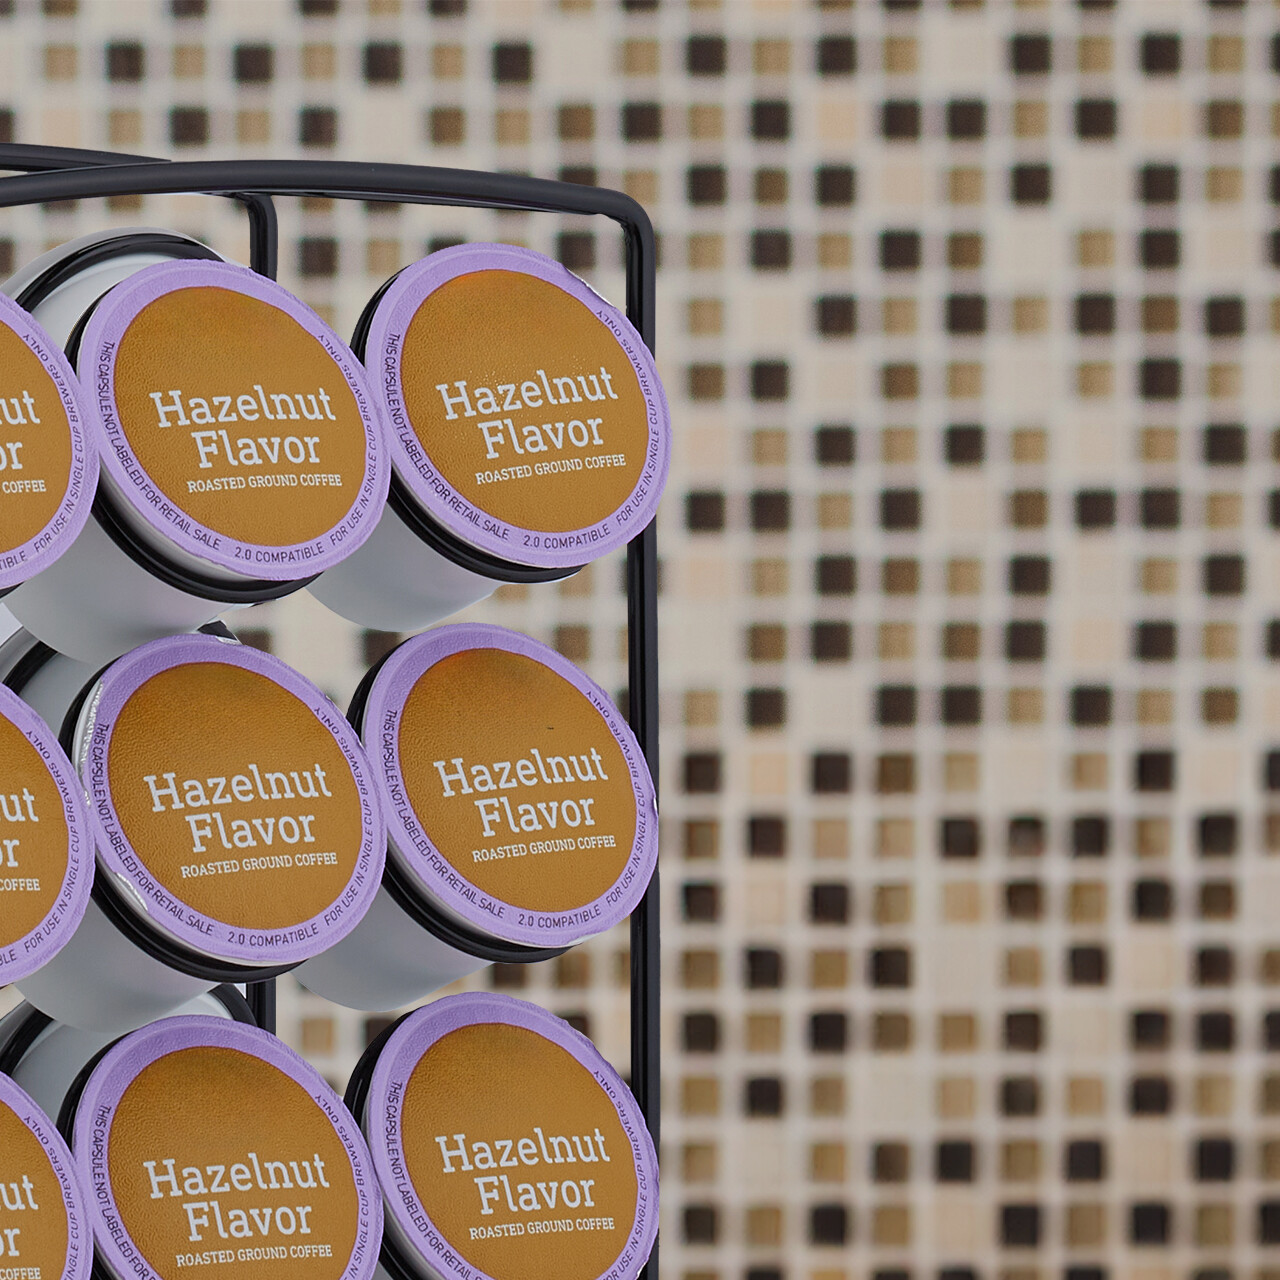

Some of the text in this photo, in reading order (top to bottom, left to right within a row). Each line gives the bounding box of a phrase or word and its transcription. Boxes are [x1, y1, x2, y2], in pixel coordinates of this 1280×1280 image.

[150, 385, 336, 427] Hazelnut
[435, 367, 619, 420] Hazelnut
[22, 332, 84, 553] FOR USE IN SINGLE CUP BREWERS ONLY
[191, 430, 320, 469] Flavor
[477, 417, 603, 459] Flavor
[2, 480, 47, 494] COFFEE
[186, 473, 342, 493] ROASTED GROUND COFFEE
[474, 454, 626, 485] ROASTED GROUND COFFEE
[235, 540, 325, 563] 2.0 COMPATIBLE
[524, 523, 611, 549] 2.0 COMPATIBLE
[143, 763, 332, 812] Hazelnut
[433, 748, 610, 797] Hazelnut
[92, 723, 215, 936] THIS CAPSULE NOT LABELED FOR RETAIL SALE
[185, 812, 315, 853] Flavor
[314, 706, 374, 925] FOR USE IN SINGLE CUP BREWERS ONLY
[473, 796, 595, 837] Flavor
[180, 852, 338, 879] ROASTED GROUND COFFEE
[471, 835, 617, 862] ROASTED GROUND COFFEE
[228, 922, 320, 947] 2.0 COMPATIBLE
[518, 903, 603, 928] 2.0 COMPATIBLE
[435, 1127, 612, 1173] Hazelnut
[143, 1151, 330, 1198] Hazelnut
[473, 1174, 595, 1215] Flavor
[182, 1200, 312, 1241] Flavor
[468, 1218, 616, 1240] ROASTED GROUND COFFEE
[175, 1245, 332, 1266] ROASTED GROUND COFFEE
